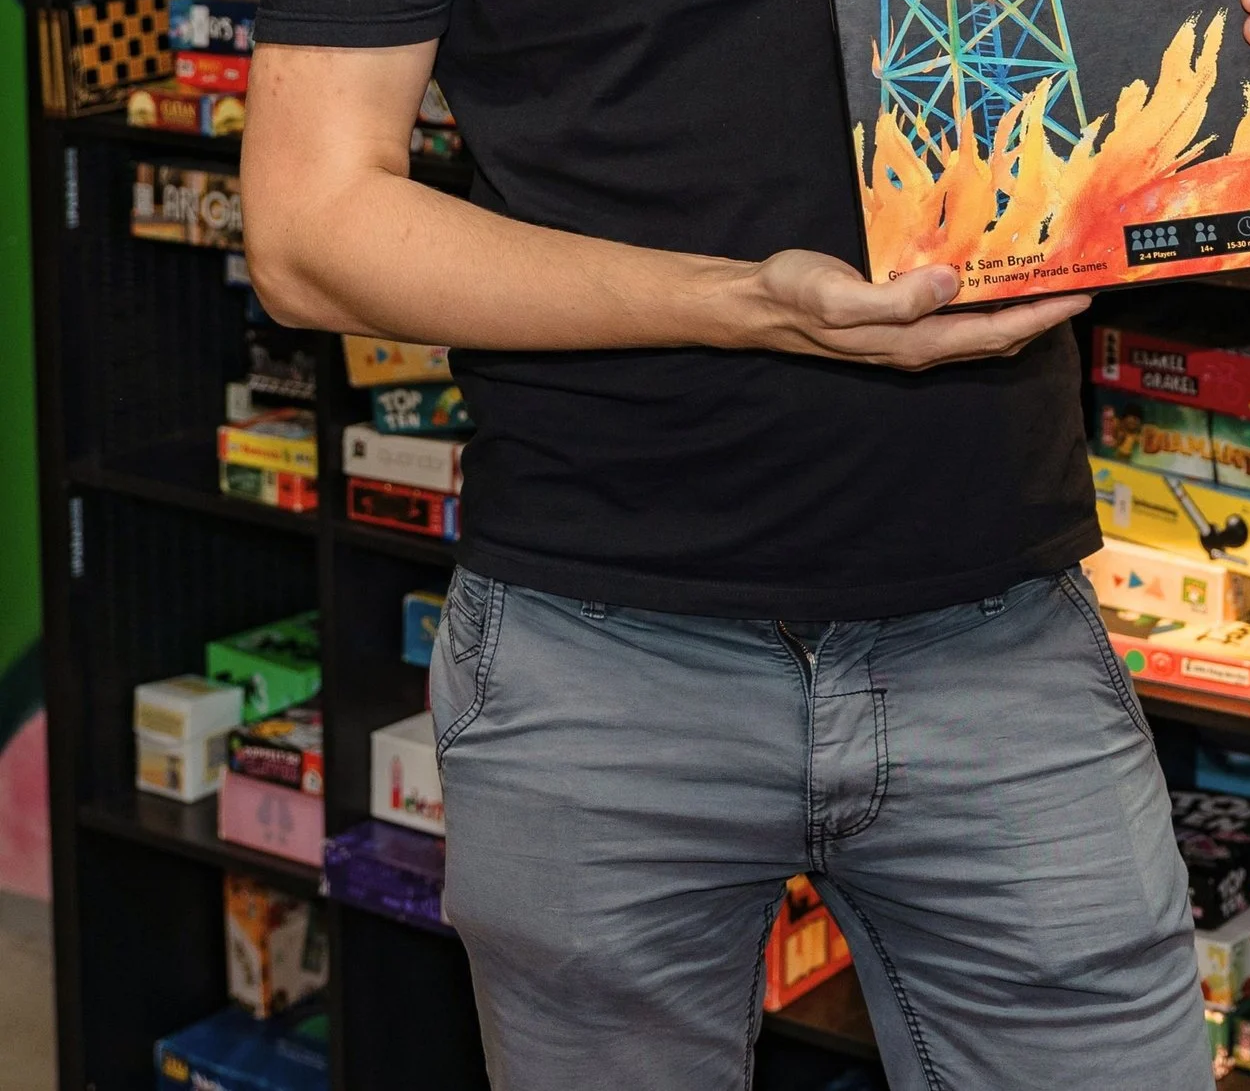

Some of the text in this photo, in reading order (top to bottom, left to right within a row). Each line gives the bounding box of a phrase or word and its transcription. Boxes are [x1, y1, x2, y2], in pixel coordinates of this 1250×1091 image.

[1227, 240, 1247, 250] 15-30
[965, 252, 1045, 272] & Sam Bryant
[1153, 250, 1177, 260] Players
[968, 261, 1108, 288] by Runaway Parade Games
